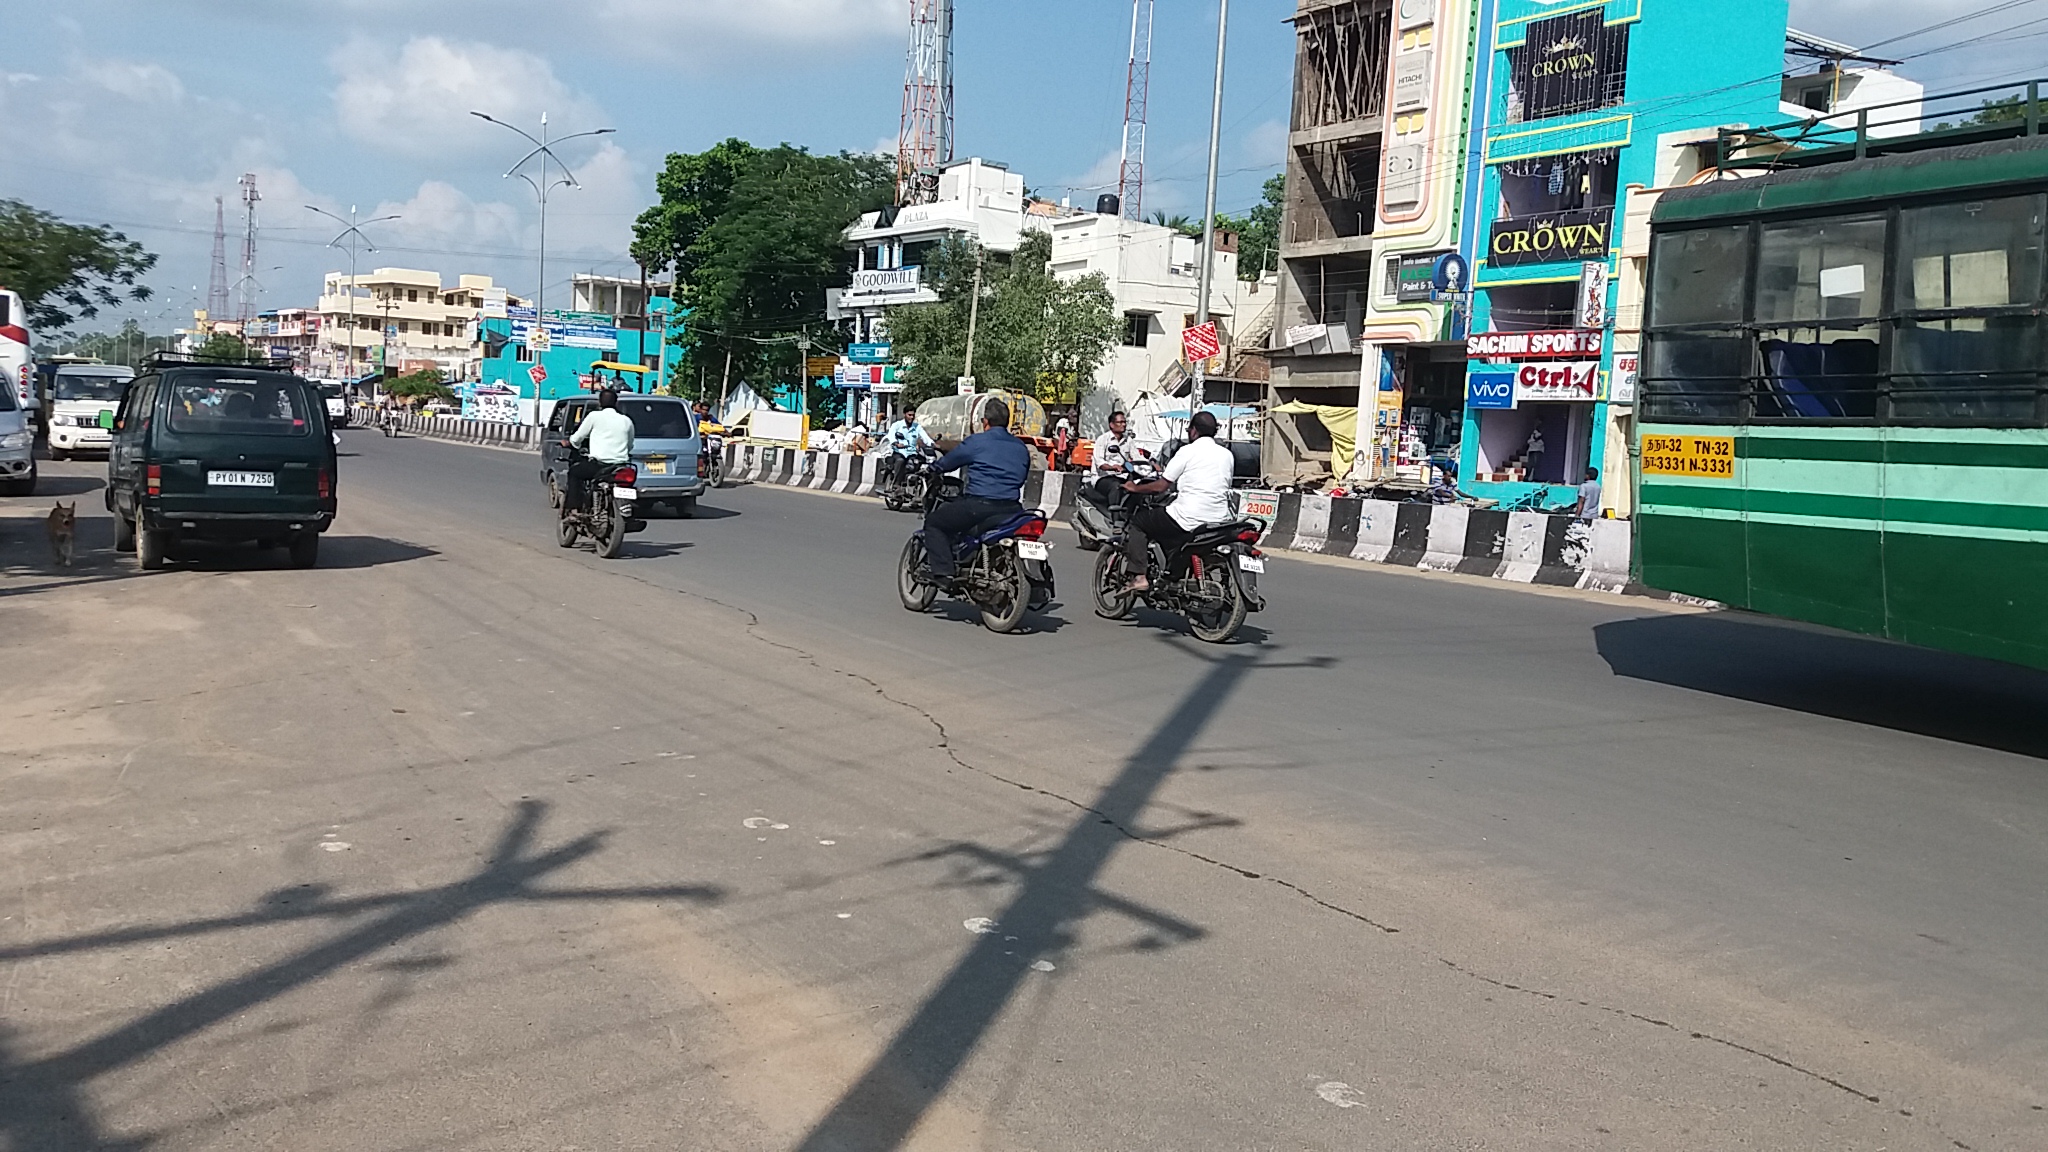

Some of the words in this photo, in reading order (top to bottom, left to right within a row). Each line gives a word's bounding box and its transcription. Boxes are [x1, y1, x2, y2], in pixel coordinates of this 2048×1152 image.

[1531, 51, 1596, 78] CROWN
[1398, 73, 1423, 85] HITACHI
[904, 211, 929, 224] PLAZA
[1493, 222, 1607, 254] CROWN
[862, 270, 914, 287] GOODWILL
[1402, 282, 1420, 291] Paint
[1420, 281, 1427, 289] &
[1466, 334, 1529, 355] SACHIN
[1530, 332, 1601, 354] SPORTS
[1472, 380, 1510, 397] vivo
[250, 473, 272, 484] 7250
[1246, 502, 1273, 515] 2300
